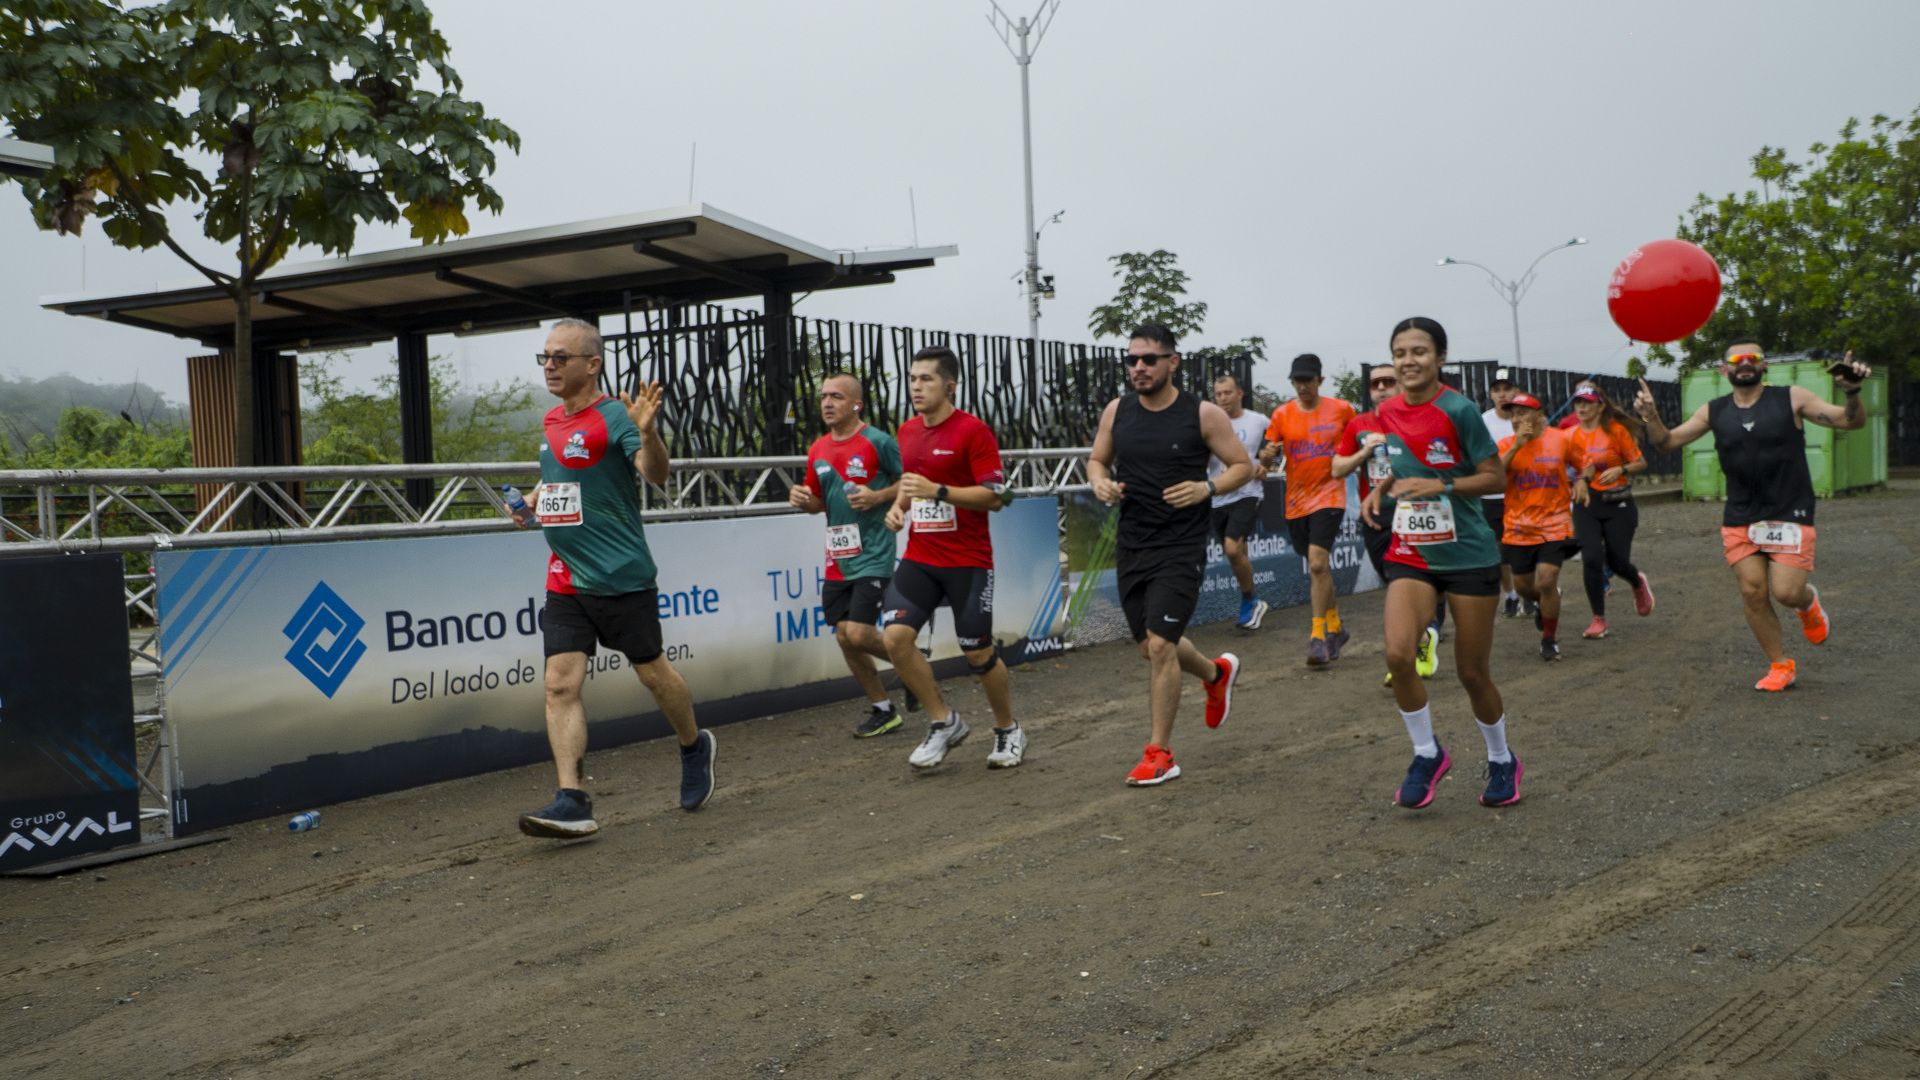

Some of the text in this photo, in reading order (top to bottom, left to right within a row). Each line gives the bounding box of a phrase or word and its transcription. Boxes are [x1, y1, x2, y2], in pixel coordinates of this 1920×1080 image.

[541, 497, 569, 512] 1667
[918, 506, 944, 519] 1521
[1408, 516, 1436, 531] 846
[1766, 532, 1782, 541] 44
[1206, 533, 1286, 563] de idente
[767, 569, 802, 601] TU
[1202, 575, 1215, 593] de
[385, 609, 507, 652] Banco
[1024, 636, 1063, 655] AVAL
[391, 671, 434, 704] Del
[444, 665, 499, 697] lado
[506, 659, 535, 686] de
[10, 810, 67, 829] Grupo
[0, 811, 133, 857] AVAL
